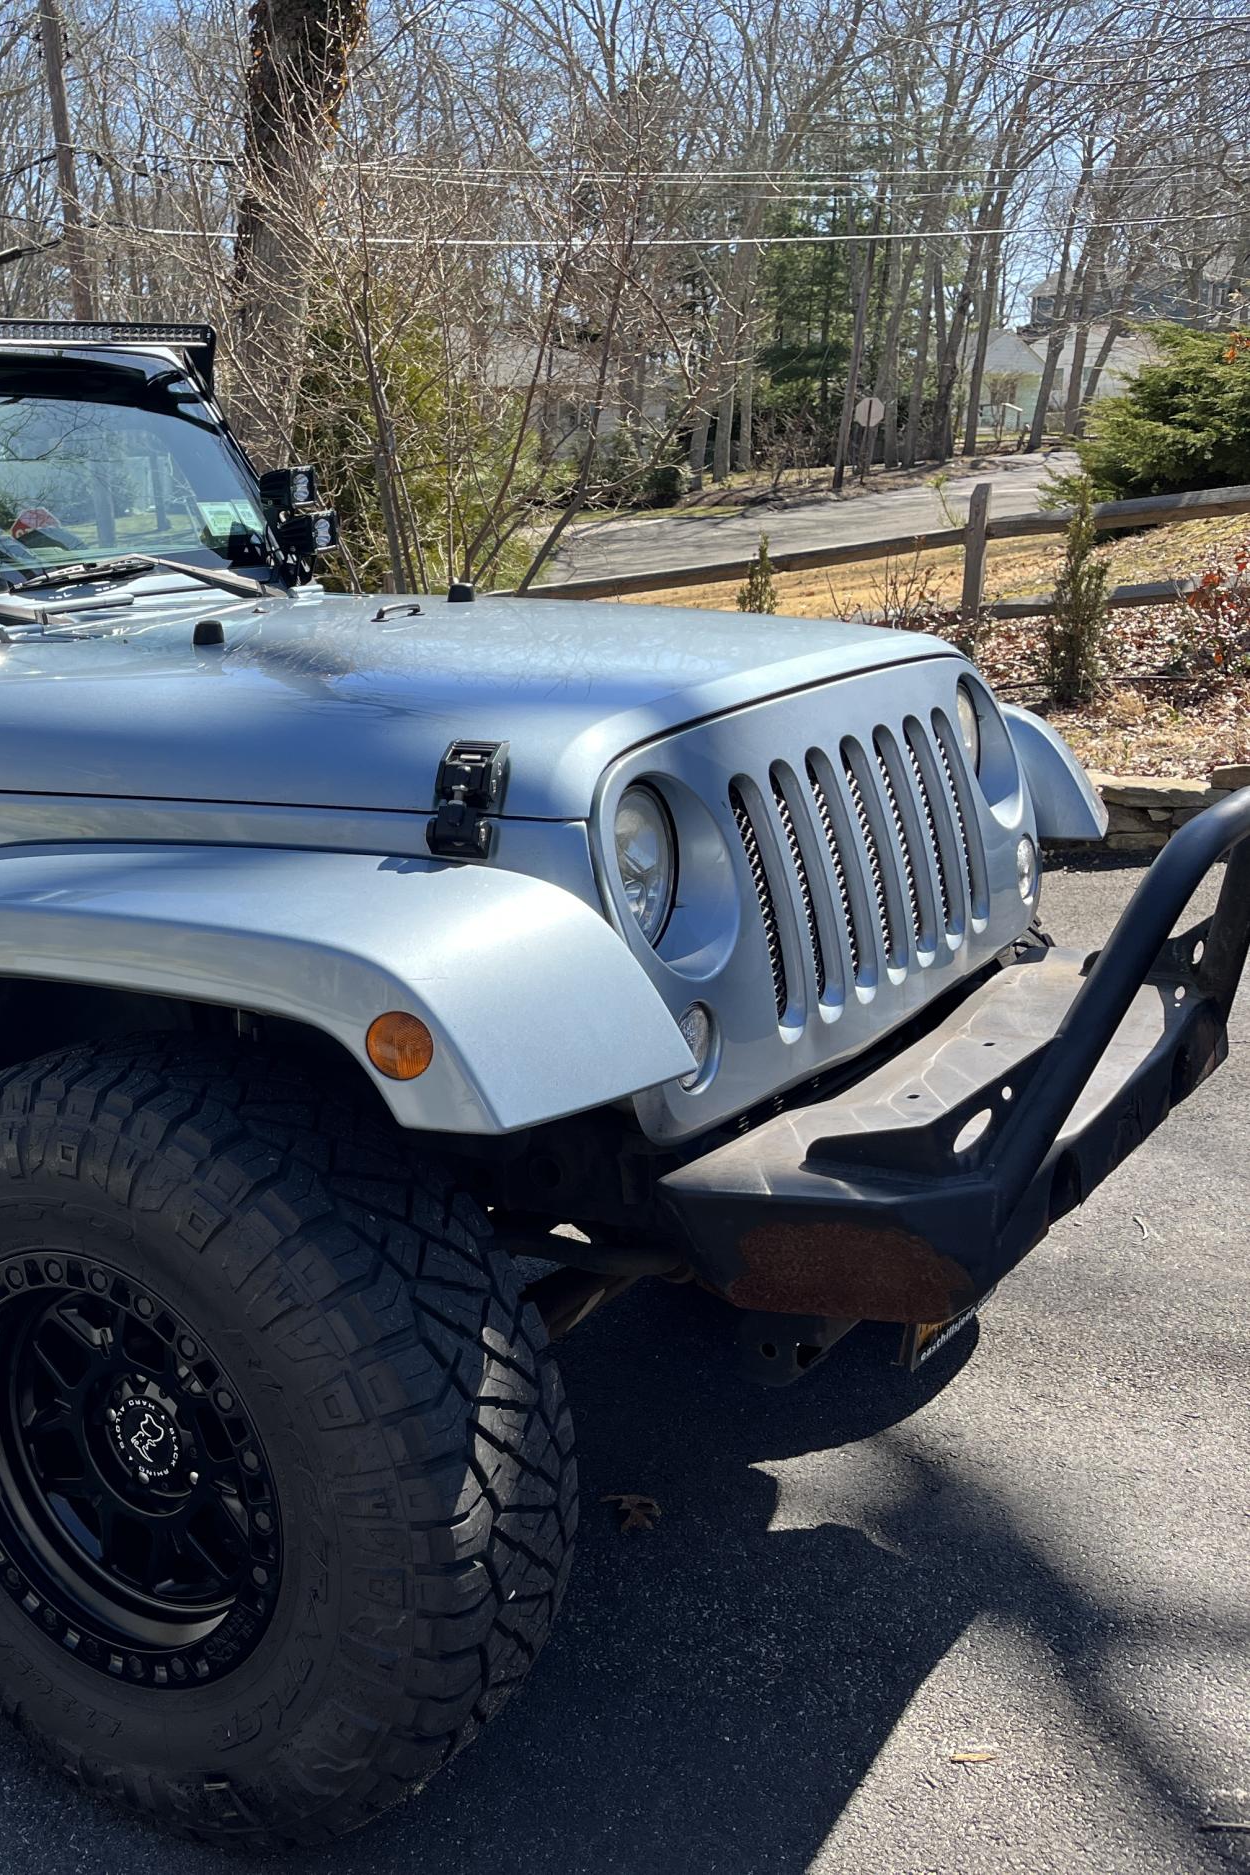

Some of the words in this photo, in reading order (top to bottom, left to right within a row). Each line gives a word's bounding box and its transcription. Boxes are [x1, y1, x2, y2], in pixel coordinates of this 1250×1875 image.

[128, 1399, 156, 1411] HARD
[114, 1406, 126, 1450] ALLOYS
[168, 1427, 179, 1467] BLACK
[138, 1465, 170, 1477] RHINO
